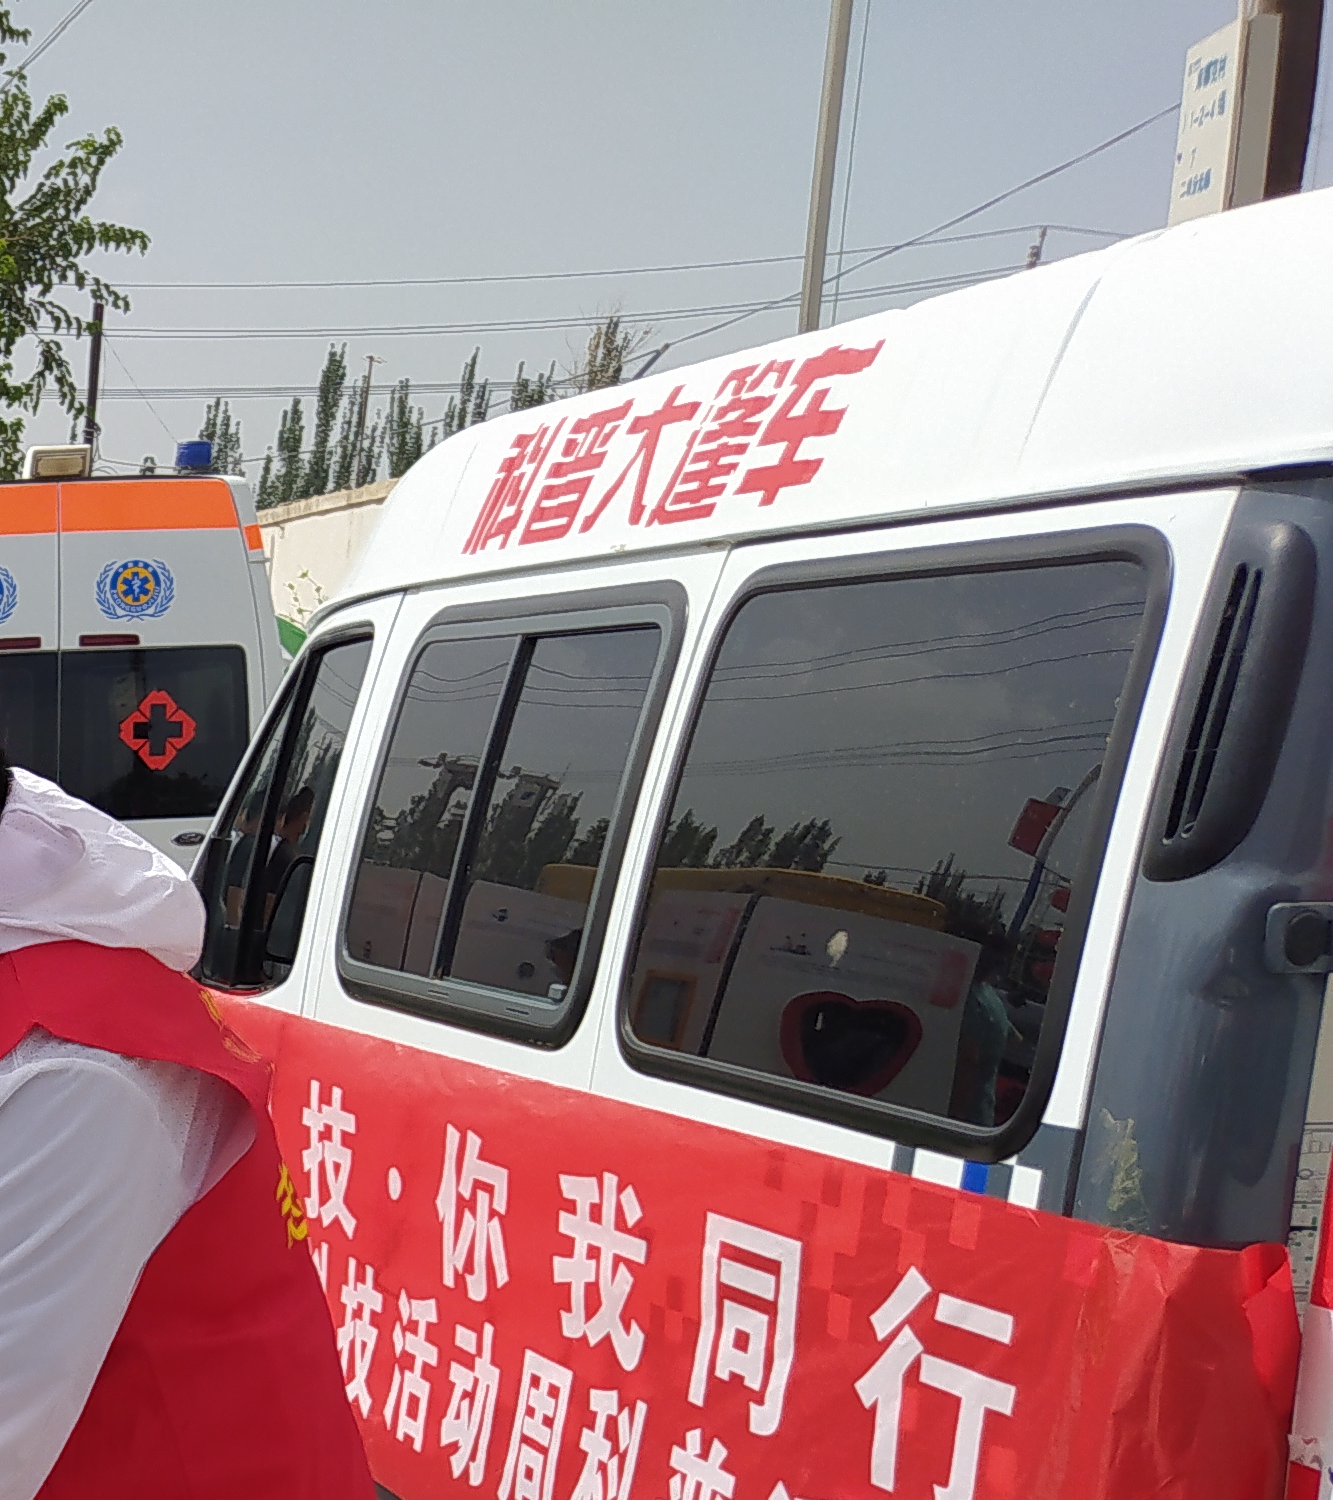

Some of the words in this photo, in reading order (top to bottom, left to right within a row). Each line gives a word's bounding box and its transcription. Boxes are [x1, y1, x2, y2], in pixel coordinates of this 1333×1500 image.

[461, 339, 886, 555] 科普大篷车
